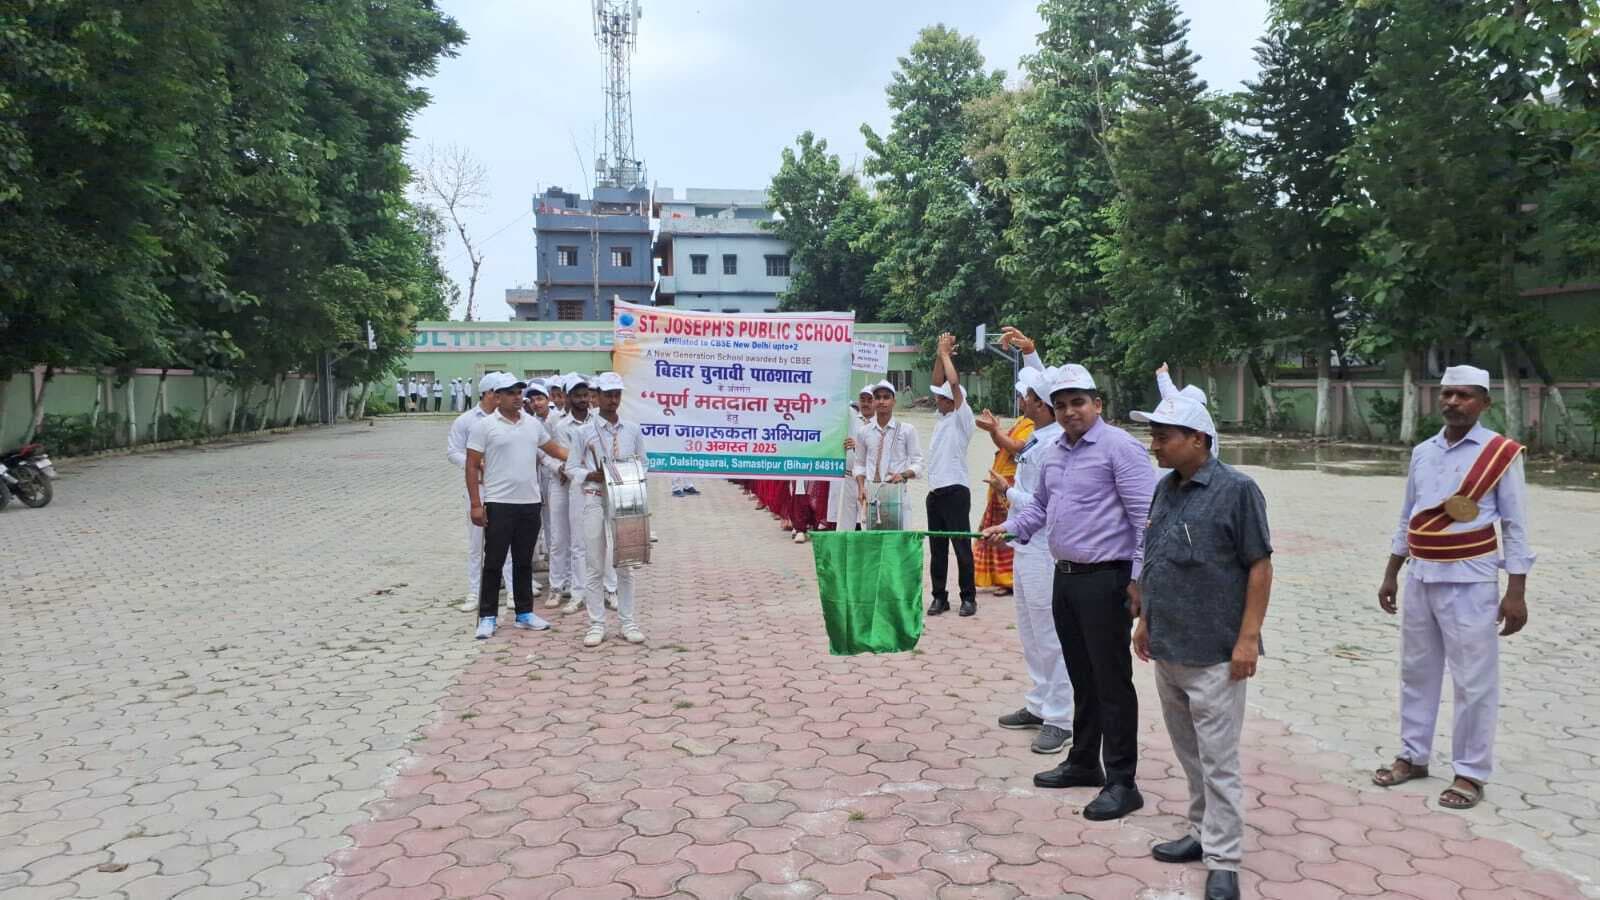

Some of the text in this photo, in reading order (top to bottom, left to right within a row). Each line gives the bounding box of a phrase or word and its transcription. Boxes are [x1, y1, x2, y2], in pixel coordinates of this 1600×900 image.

[639, 314, 852, 342] ST. JOSEPH'S PUBLIC SCHOOL
[416, 330, 614, 347] ULTIPURPOSE
[663, 336, 698, 347] Affiliated
[700, 338, 709, 347] to
[710, 339, 732, 348] CBSE
[733, 341, 750, 350] New
[751, 341, 771, 350] Delhi
[647, 349, 812, 365] A New Generation School awarded by CBSE
[655, 359, 813, 384] बिहार चुनावी पाठशाला
[694, 394, 768, 412] मतदाता
[640, 423, 822, 442] जन जागरूकता अभियान
[684, 439, 777, 453] 30 अगस्त 2025
[731, 458, 782, 471] Samastipur
[783, 460, 813, 472] (Bihar)
[814, 461, 845, 471] 848114
